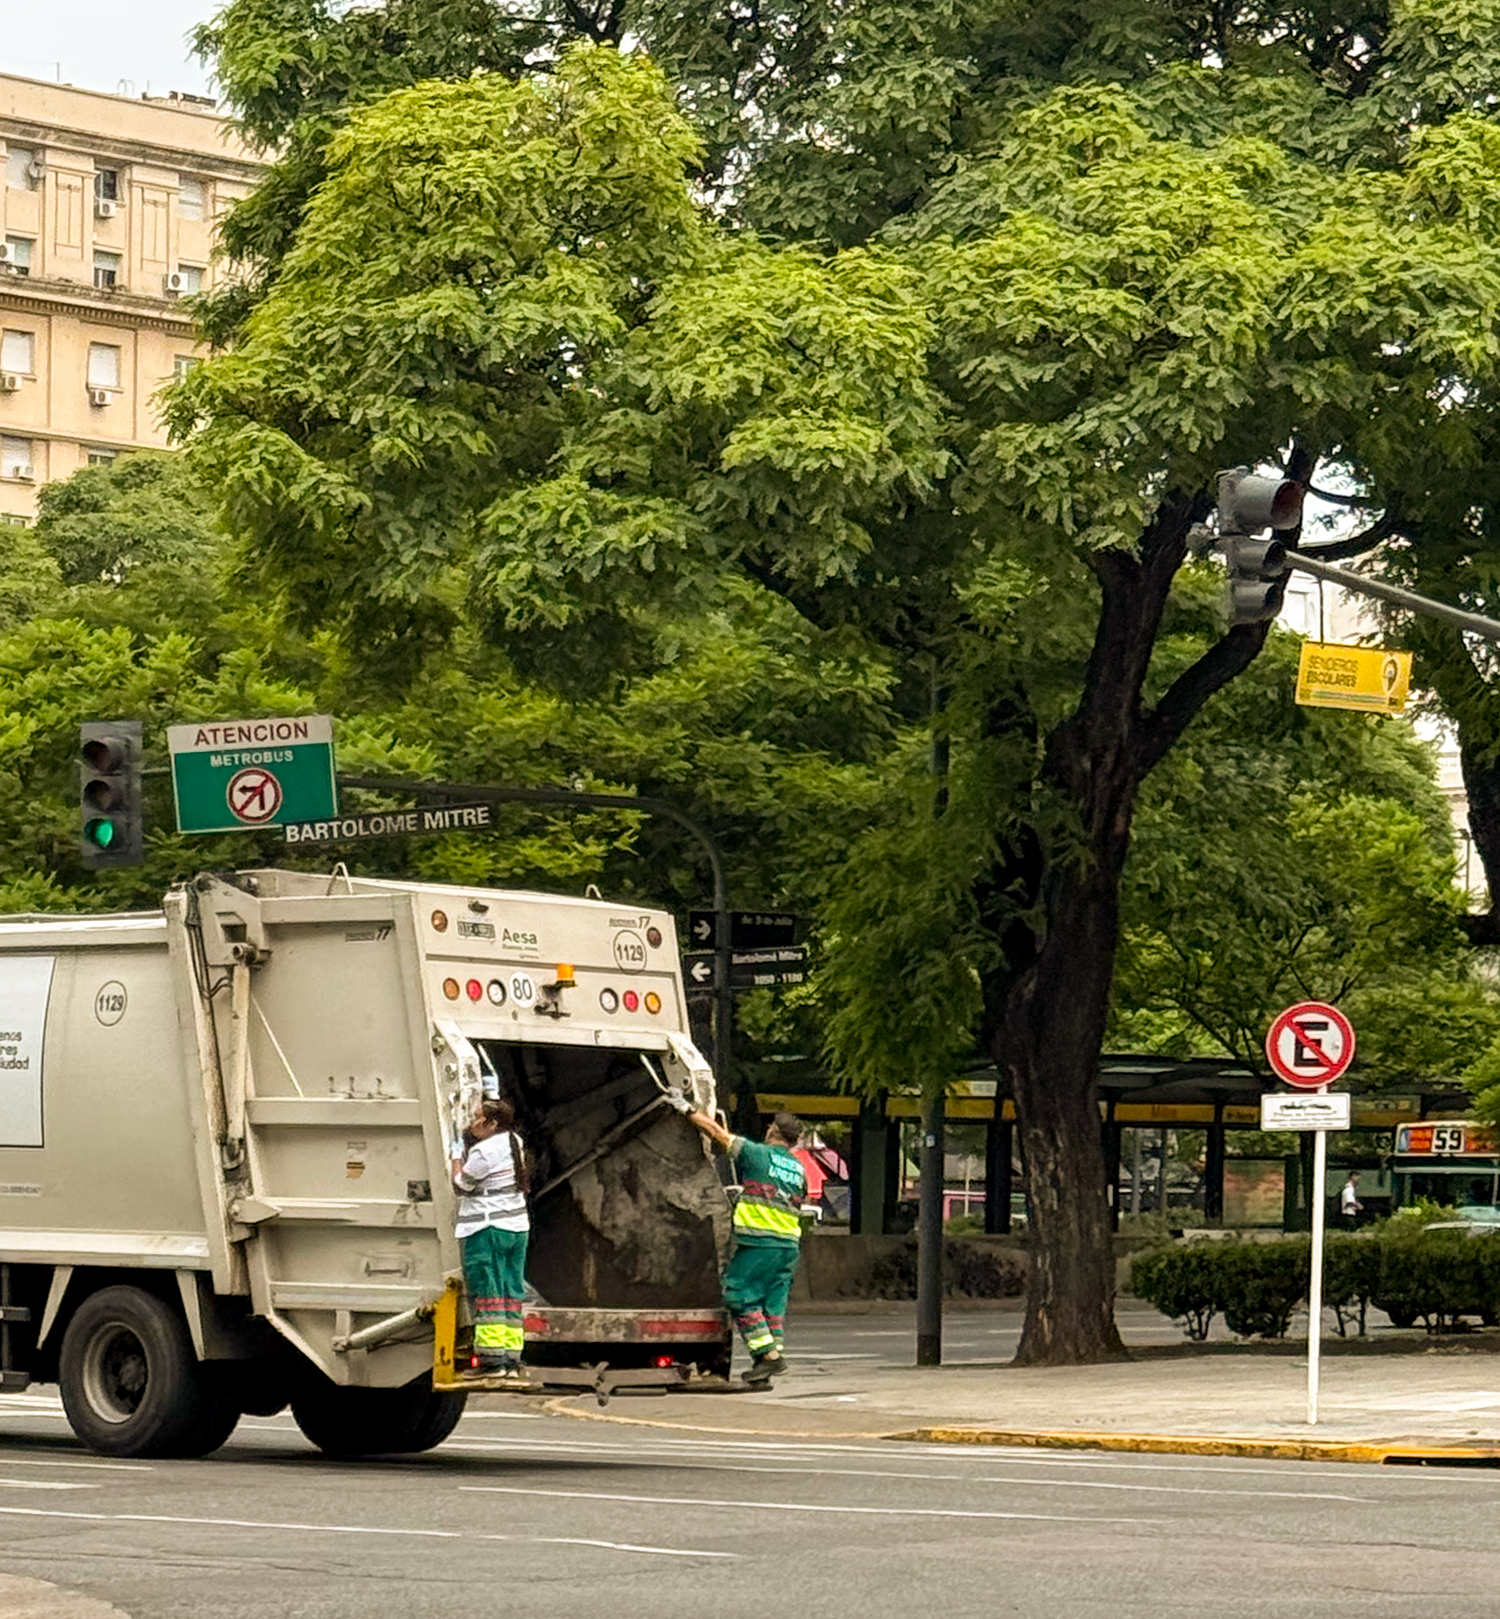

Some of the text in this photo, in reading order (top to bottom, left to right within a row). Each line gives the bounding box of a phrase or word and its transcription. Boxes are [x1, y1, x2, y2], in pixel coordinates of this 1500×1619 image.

[194, 721, 309, 746] ATENCION
[210, 750, 294, 767] METROBUS
[286, 806, 490, 843] BARTOLOME MITRE
[503, 928, 538, 945] Aesa
[616, 943, 644, 962] 1129
[513, 978, 533, 1000] 80
[99, 994, 124, 1012] 1129
[1434, 1129, 1462, 1151] 59
